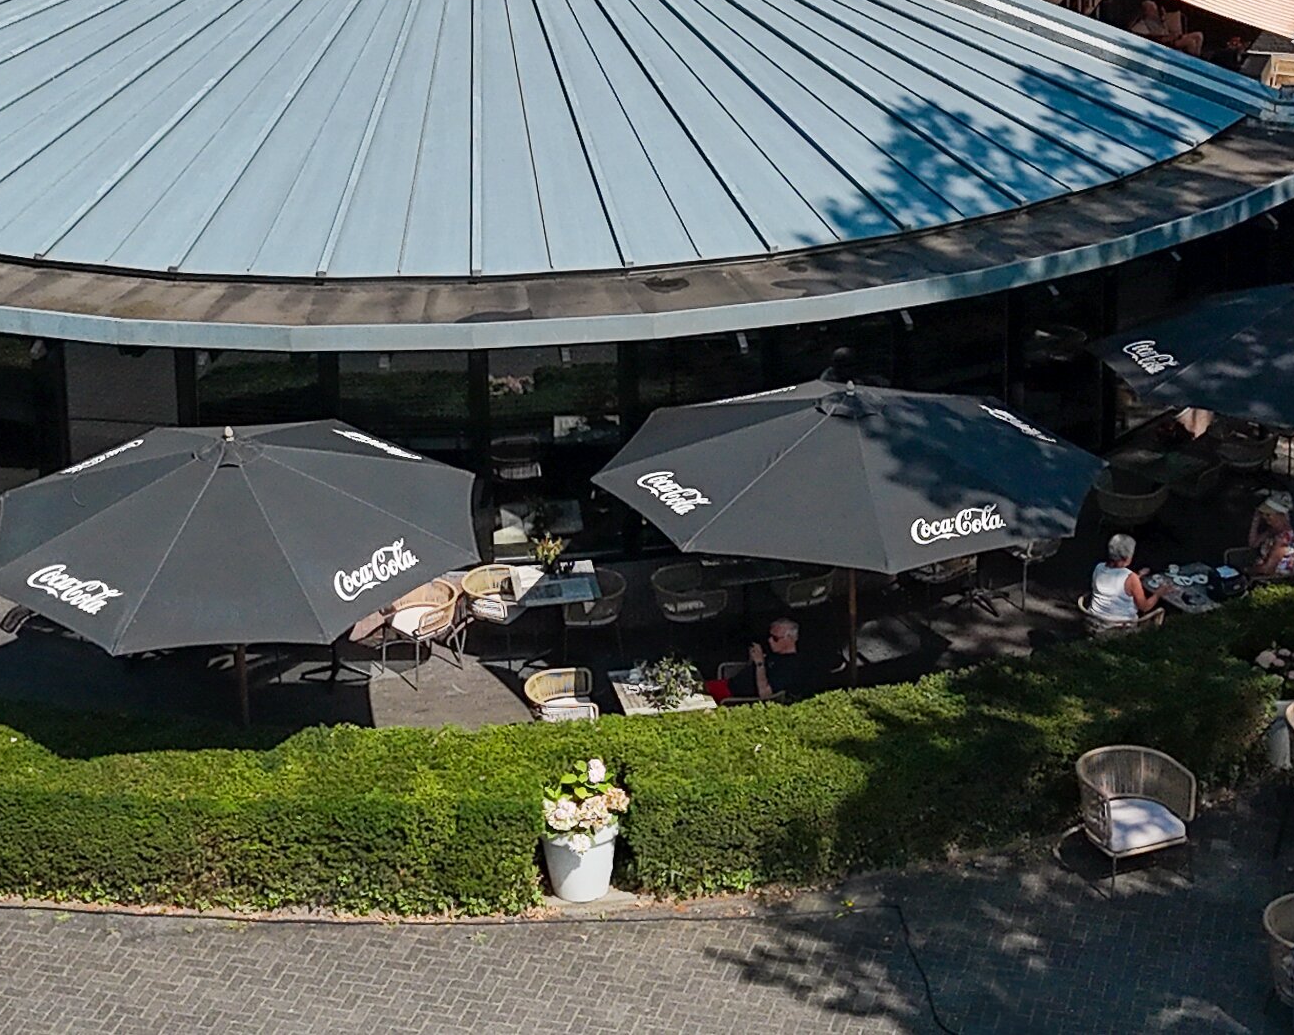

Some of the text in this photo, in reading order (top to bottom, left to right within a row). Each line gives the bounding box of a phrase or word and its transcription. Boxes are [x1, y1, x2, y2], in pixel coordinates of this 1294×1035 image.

[911, 504, 1006, 544] Coca-Cola
[27, 564, 123, 615] Coca-Cola
[333, 538, 419, 601] Coca-Cola
